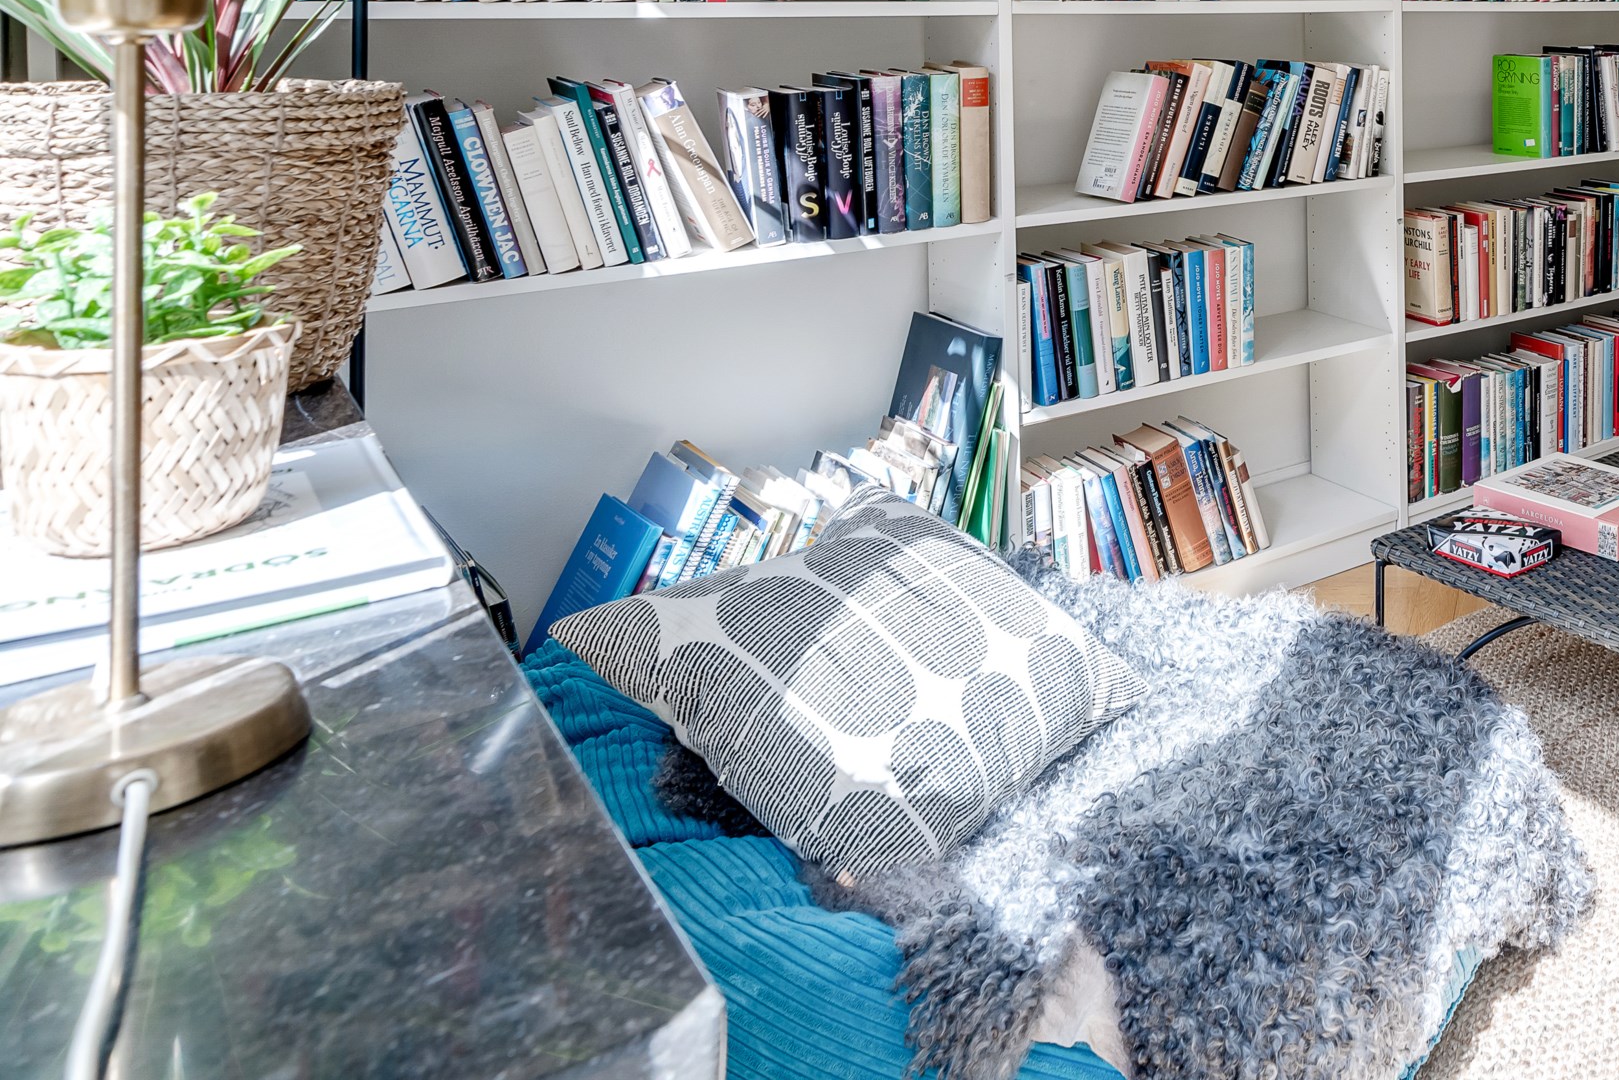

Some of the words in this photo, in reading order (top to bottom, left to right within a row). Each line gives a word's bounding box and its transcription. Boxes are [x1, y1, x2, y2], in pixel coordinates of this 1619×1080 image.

[1169, 78, 1183, 100] CARIN
[1496, 71, 1541, 85] GRYNING
[1308, 79, 1331, 119] ROOTS
[563, 110, 577, 128] Saul
[668, 112, 693, 139] Alan
[1160, 102, 1179, 142] HJULSTRÖM
[569, 127, 586, 156] Bellow
[1301, 119, 1314, 151] HALEY
[1308, 121, 1321, 146] ALEX
[1333, 120, 1348, 158] FAMILJEN
[611, 132, 631, 164] SUSANNE
[580, 162, 596, 180] Han
[619, 164, 637, 184] BOLL
[680, 138, 718, 195] Greenspan
[428, 116, 452, 156] Majgull
[441, 158, 466, 203] Axelsson
[458, 205, 485, 261] Aprilhäxan
[463, 136, 507, 230] CLOWNEN
[494, 231, 519, 265] JAC
[586, 180, 599, 197] med
[590, 198, 605, 216] foten
[623, 183, 650, 226] JORDANDEN
[597, 220, 617, 254] klaveret
[1408, 268, 1421, 280] LIFE
[1409, 258, 1431, 271] EARLY
[1054, 268, 1068, 294] Kerstin
[1058, 294, 1068, 318] Ekman
[1060, 320, 1071, 354] Händelser
[1065, 366, 1075, 387] vatten
[1453, 522, 1543, 536] YATZY
[1520, 508, 1564, 526] BARCELONA
[1451, 544, 1480, 562] YATZY
[1522, 548, 1549, 566] YATZY
